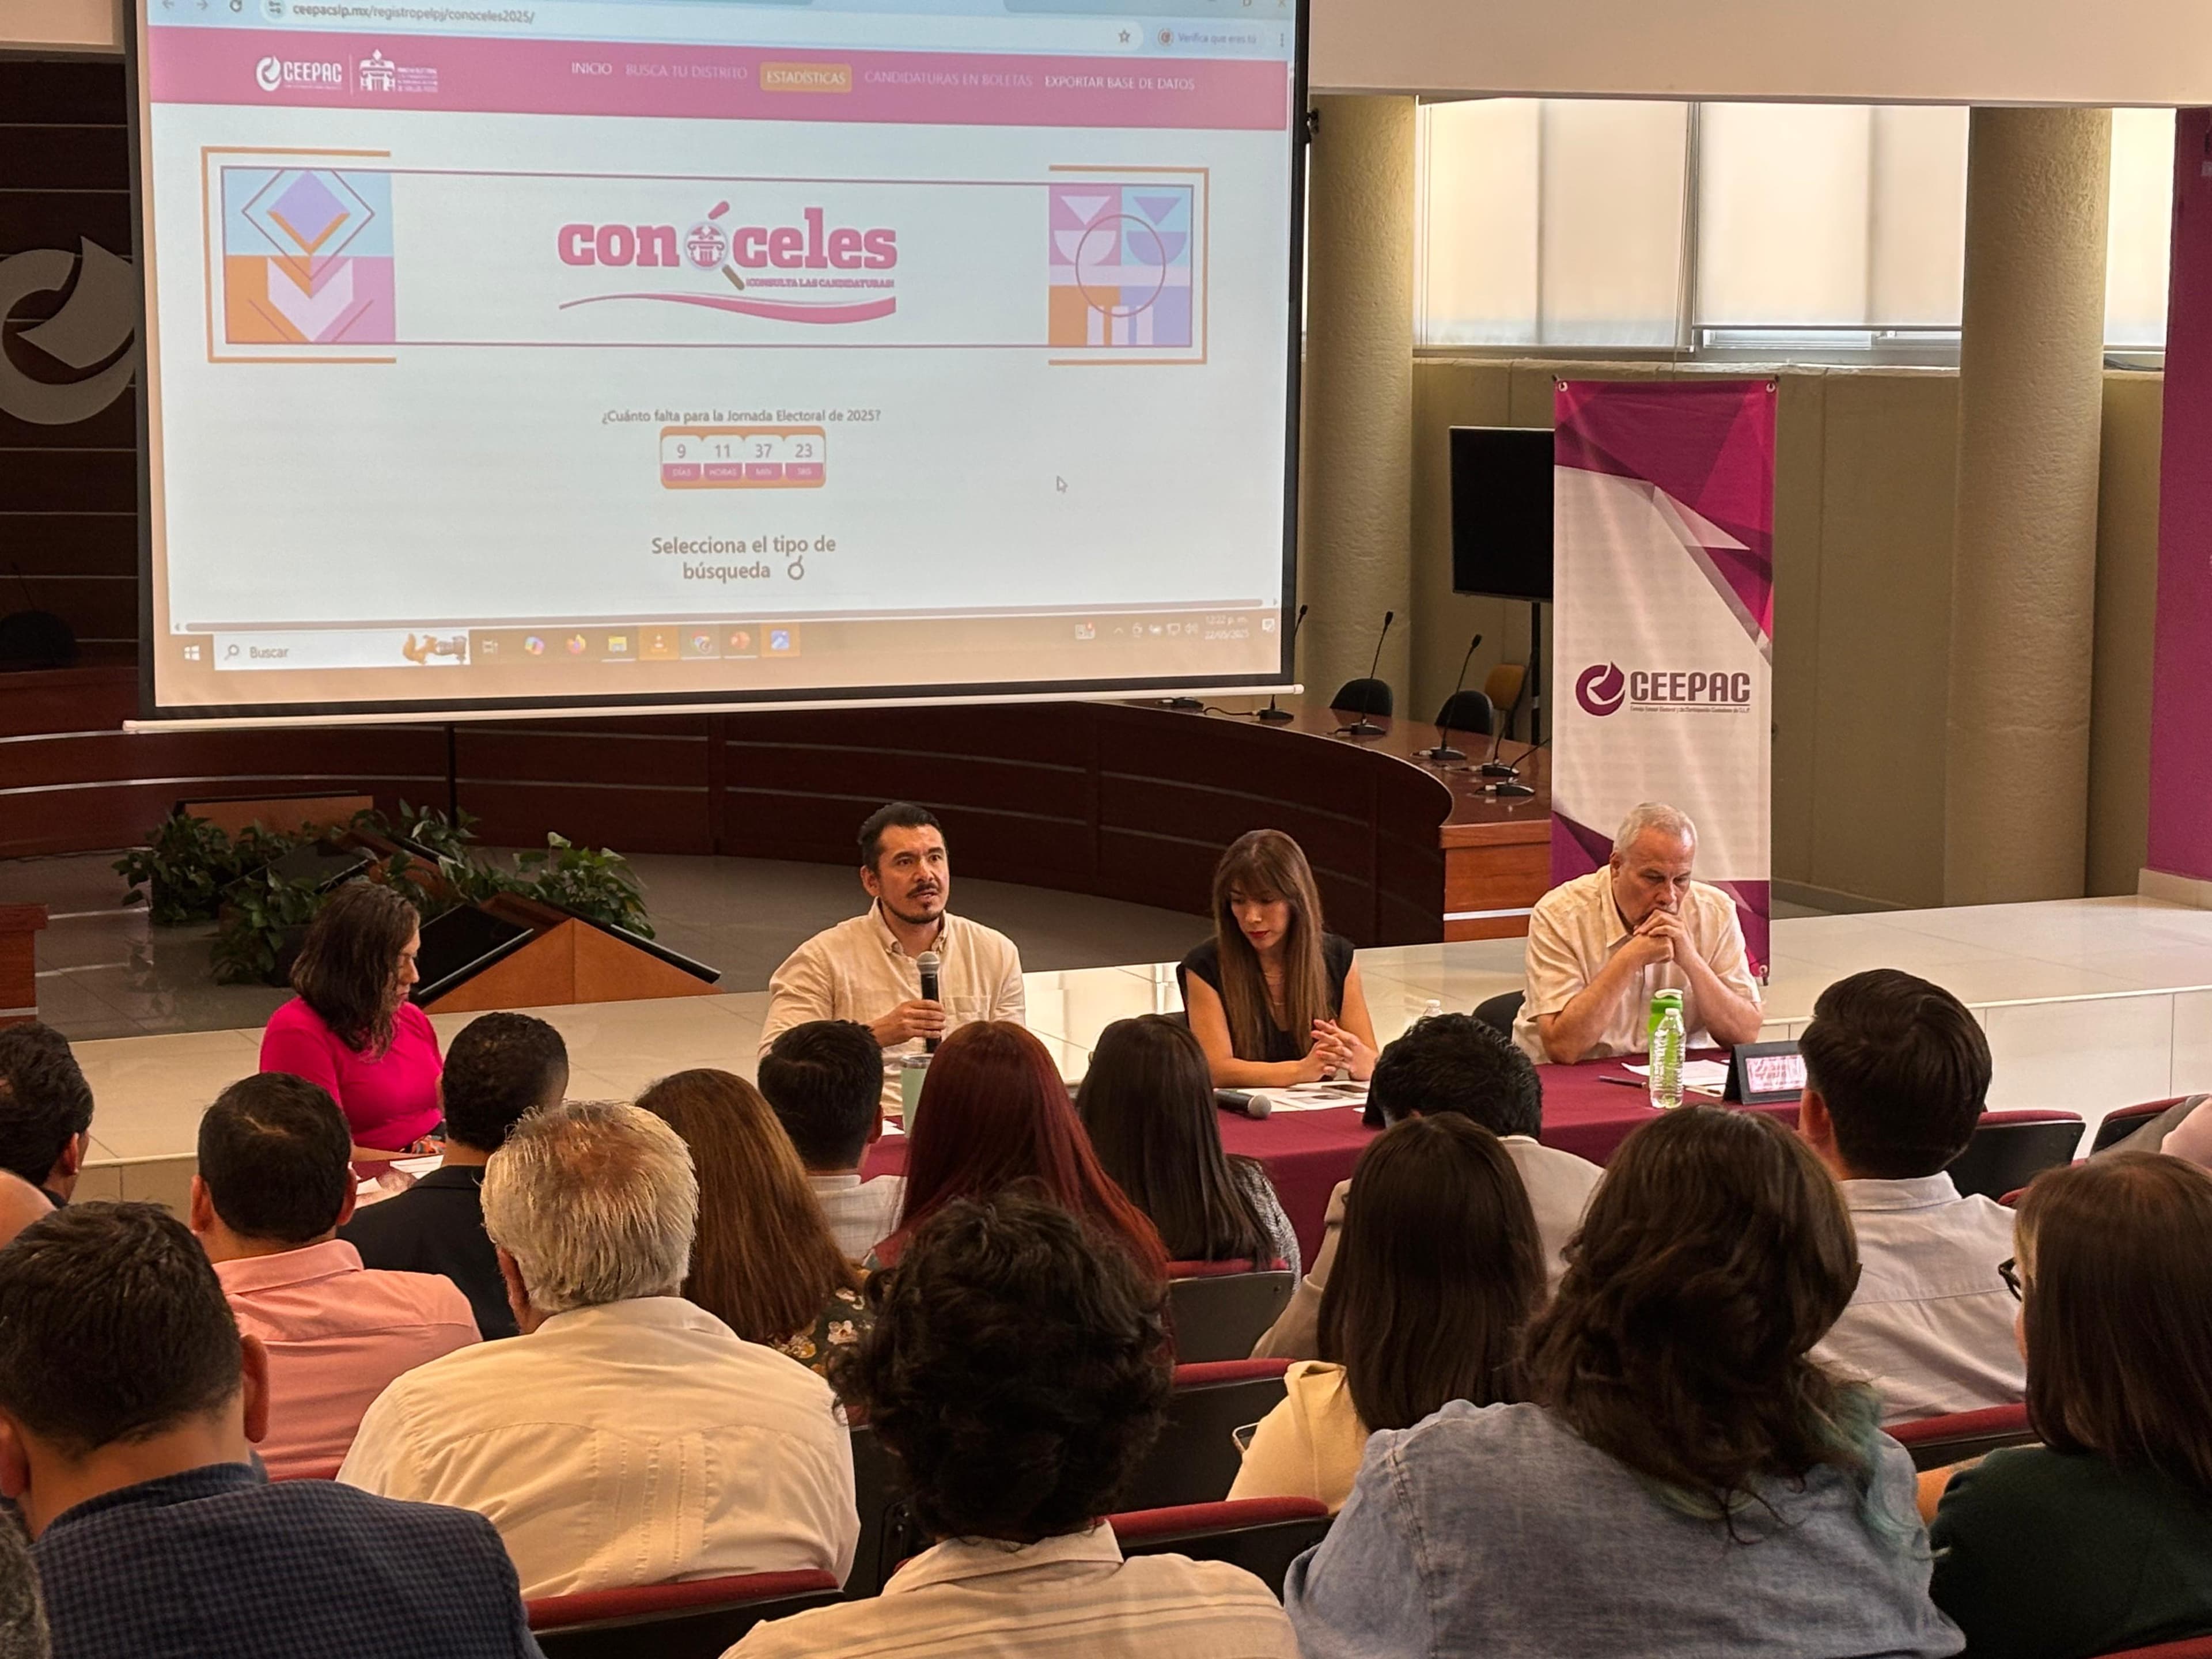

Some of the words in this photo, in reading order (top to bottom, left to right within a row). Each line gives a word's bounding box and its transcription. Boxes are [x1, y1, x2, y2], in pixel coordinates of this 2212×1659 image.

[283, 61, 342, 83] CEEPAC
[571, 62, 612, 75] INICIO
[625, 64, 668, 77] BUSCA
[672, 65, 688, 77] TU
[692, 65, 747, 79] DISTRITO
[767, 69, 846, 85] ESTADÍSTICAS
[865, 71, 959, 85] CANDIDATURAS
[963, 73, 978, 85] EN
[982, 73, 1032, 86] BOLETAS
[1045, 75, 1104, 88] EXPORTAR
[1107, 77, 1134, 89] BASE
[1139, 78, 1153, 89] DE
[1157, 78, 1195, 90] DATOS
[799, 278, 818, 287] LAS
[602, 410, 651, 425] ¿Cuánto
[654, 410, 680, 422] falta
[684, 412, 710, 425] para
[713, 410, 723, 422] la
[728, 410, 772, 422] Jornada
[777, 409, 825, 422] Electoral
[828, 410, 843, 421] de
[847, 410, 881, 422] 2025?
[677, 444, 686, 459] 9
[715, 444, 731, 459] 11
[755, 444, 772, 459] 37
[795, 444, 813, 459] 23
[709, 468, 737, 476] HORAS
[652, 536, 747, 555] Selecciona
[752, 536, 767, 552] el
[773, 535, 808, 556] tipo
[813, 535, 836, 552] de
[683, 561, 771, 584] búsqueda
[249, 646, 289, 658] Buscar
[1630, 671, 1751, 703] CEEPAC
